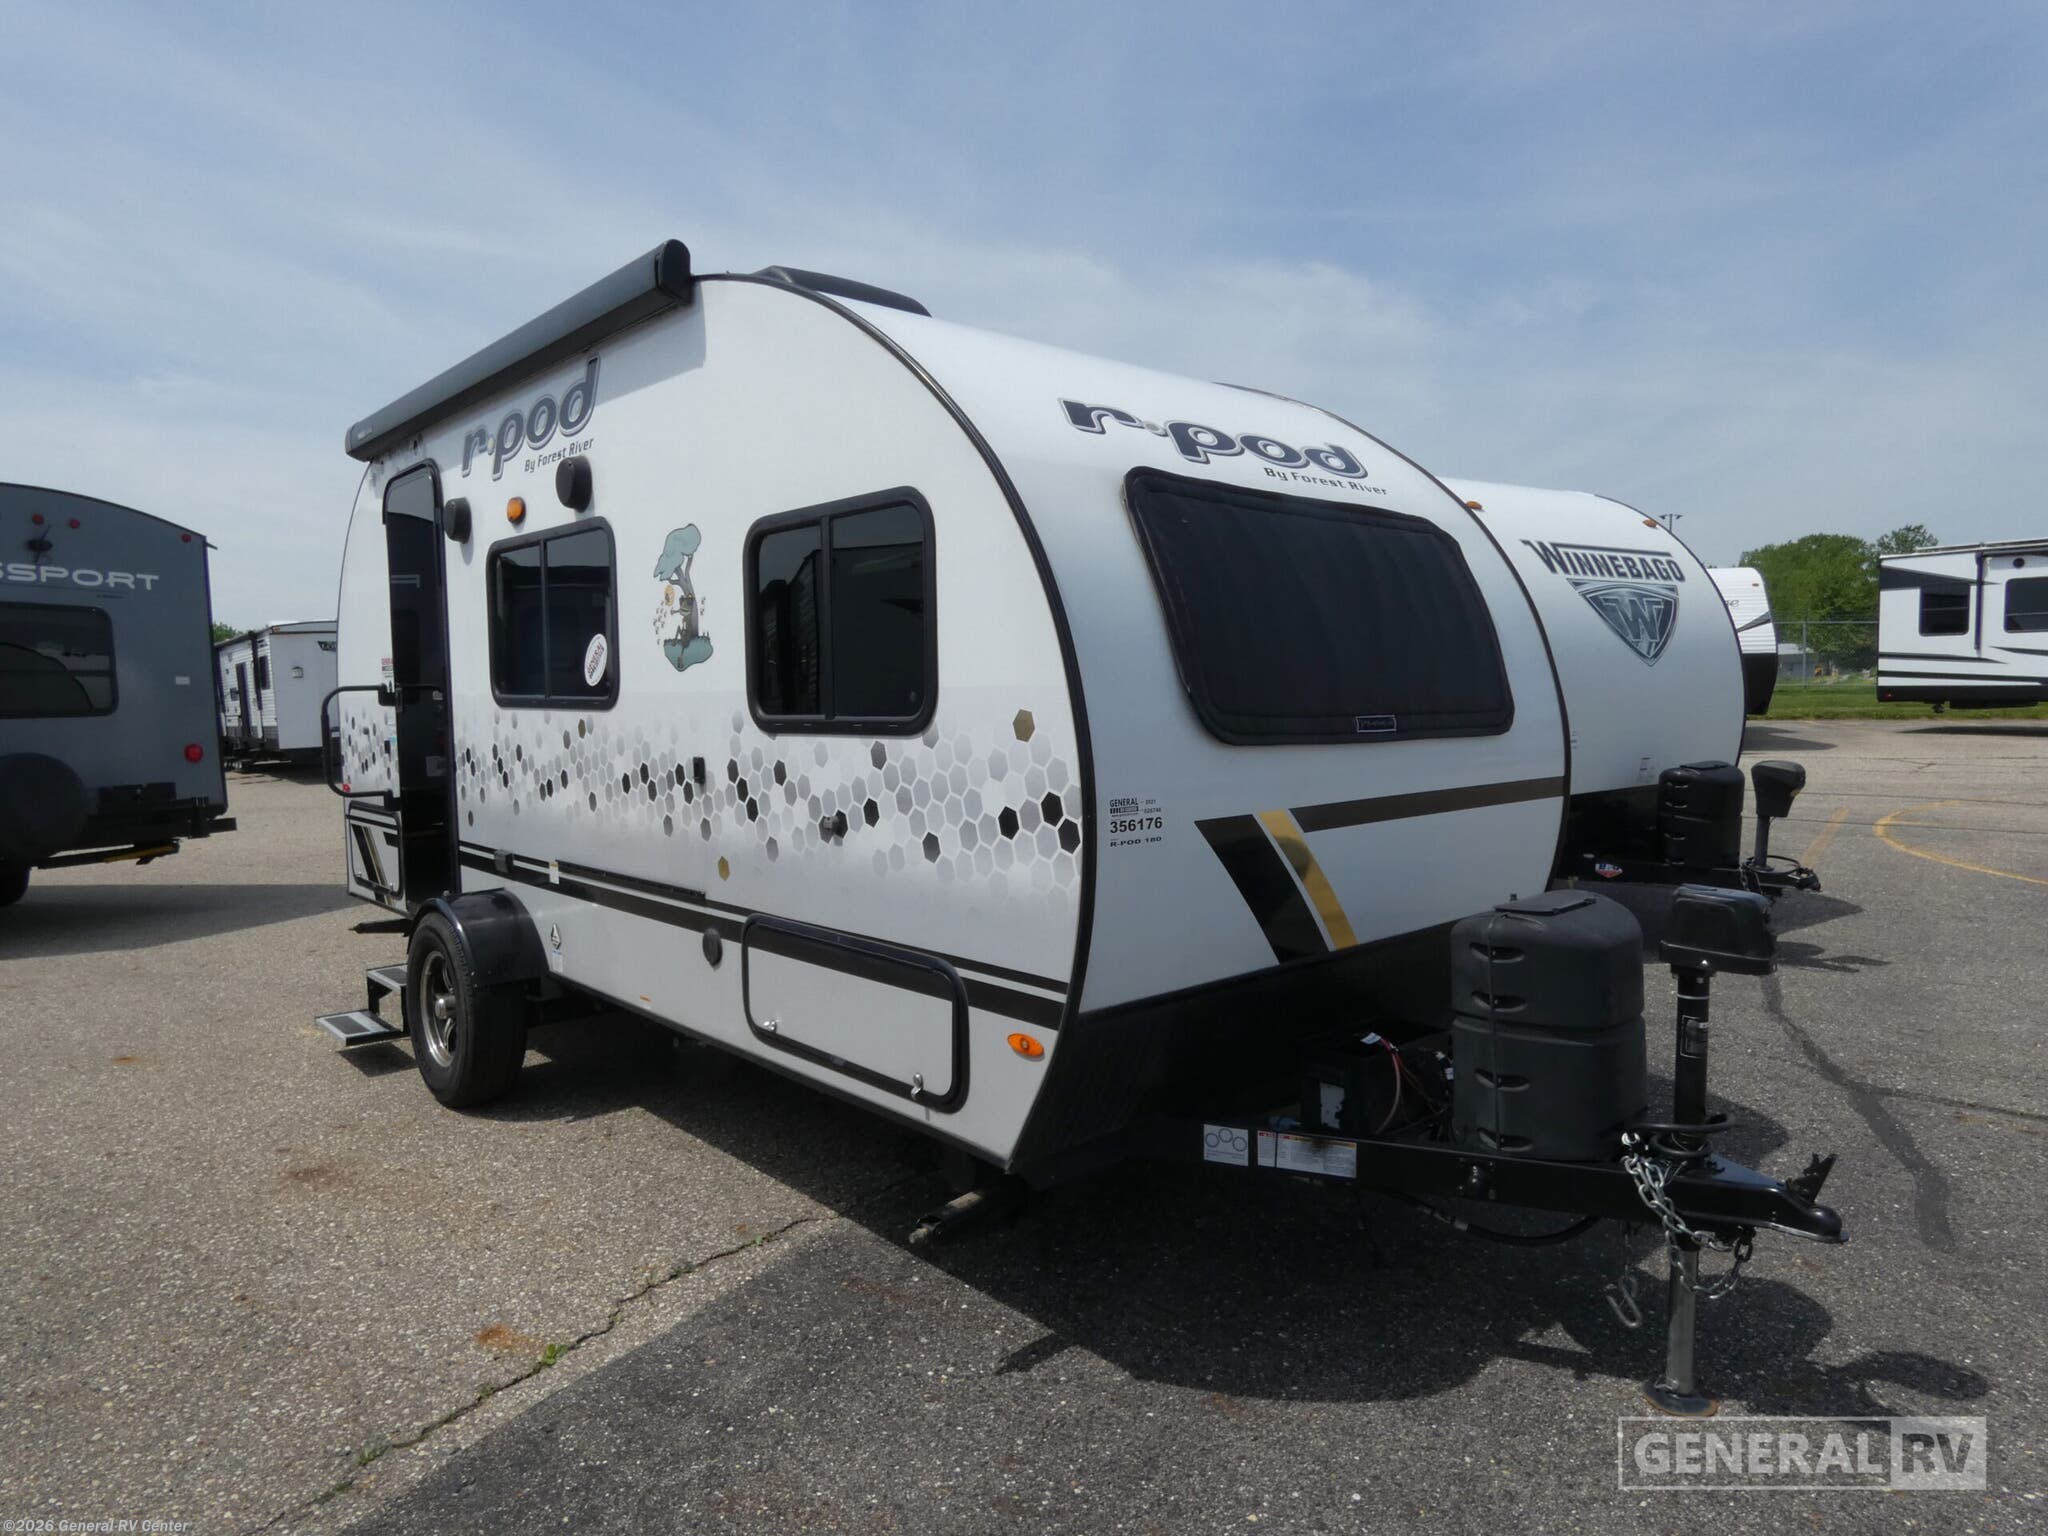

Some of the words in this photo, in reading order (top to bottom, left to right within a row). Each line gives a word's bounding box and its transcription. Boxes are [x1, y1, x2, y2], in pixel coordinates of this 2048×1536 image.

[524, 459, 537, 473] By
[538, 447, 567, 467] Forest
[569, 438, 595, 456] River
[1264, 467, 1289, 481] By
[1291, 472, 1347, 488] Forest
[1348, 481, 1388, 495] River
[1520, 539, 1686, 582] WINNEBAGO
[0, 562, 160, 591] SPORT
[1109, 798, 1139, 807] GENERAL
[1110, 817, 1163, 834] 356176
[1110, 839, 1141, 848] R-POD
